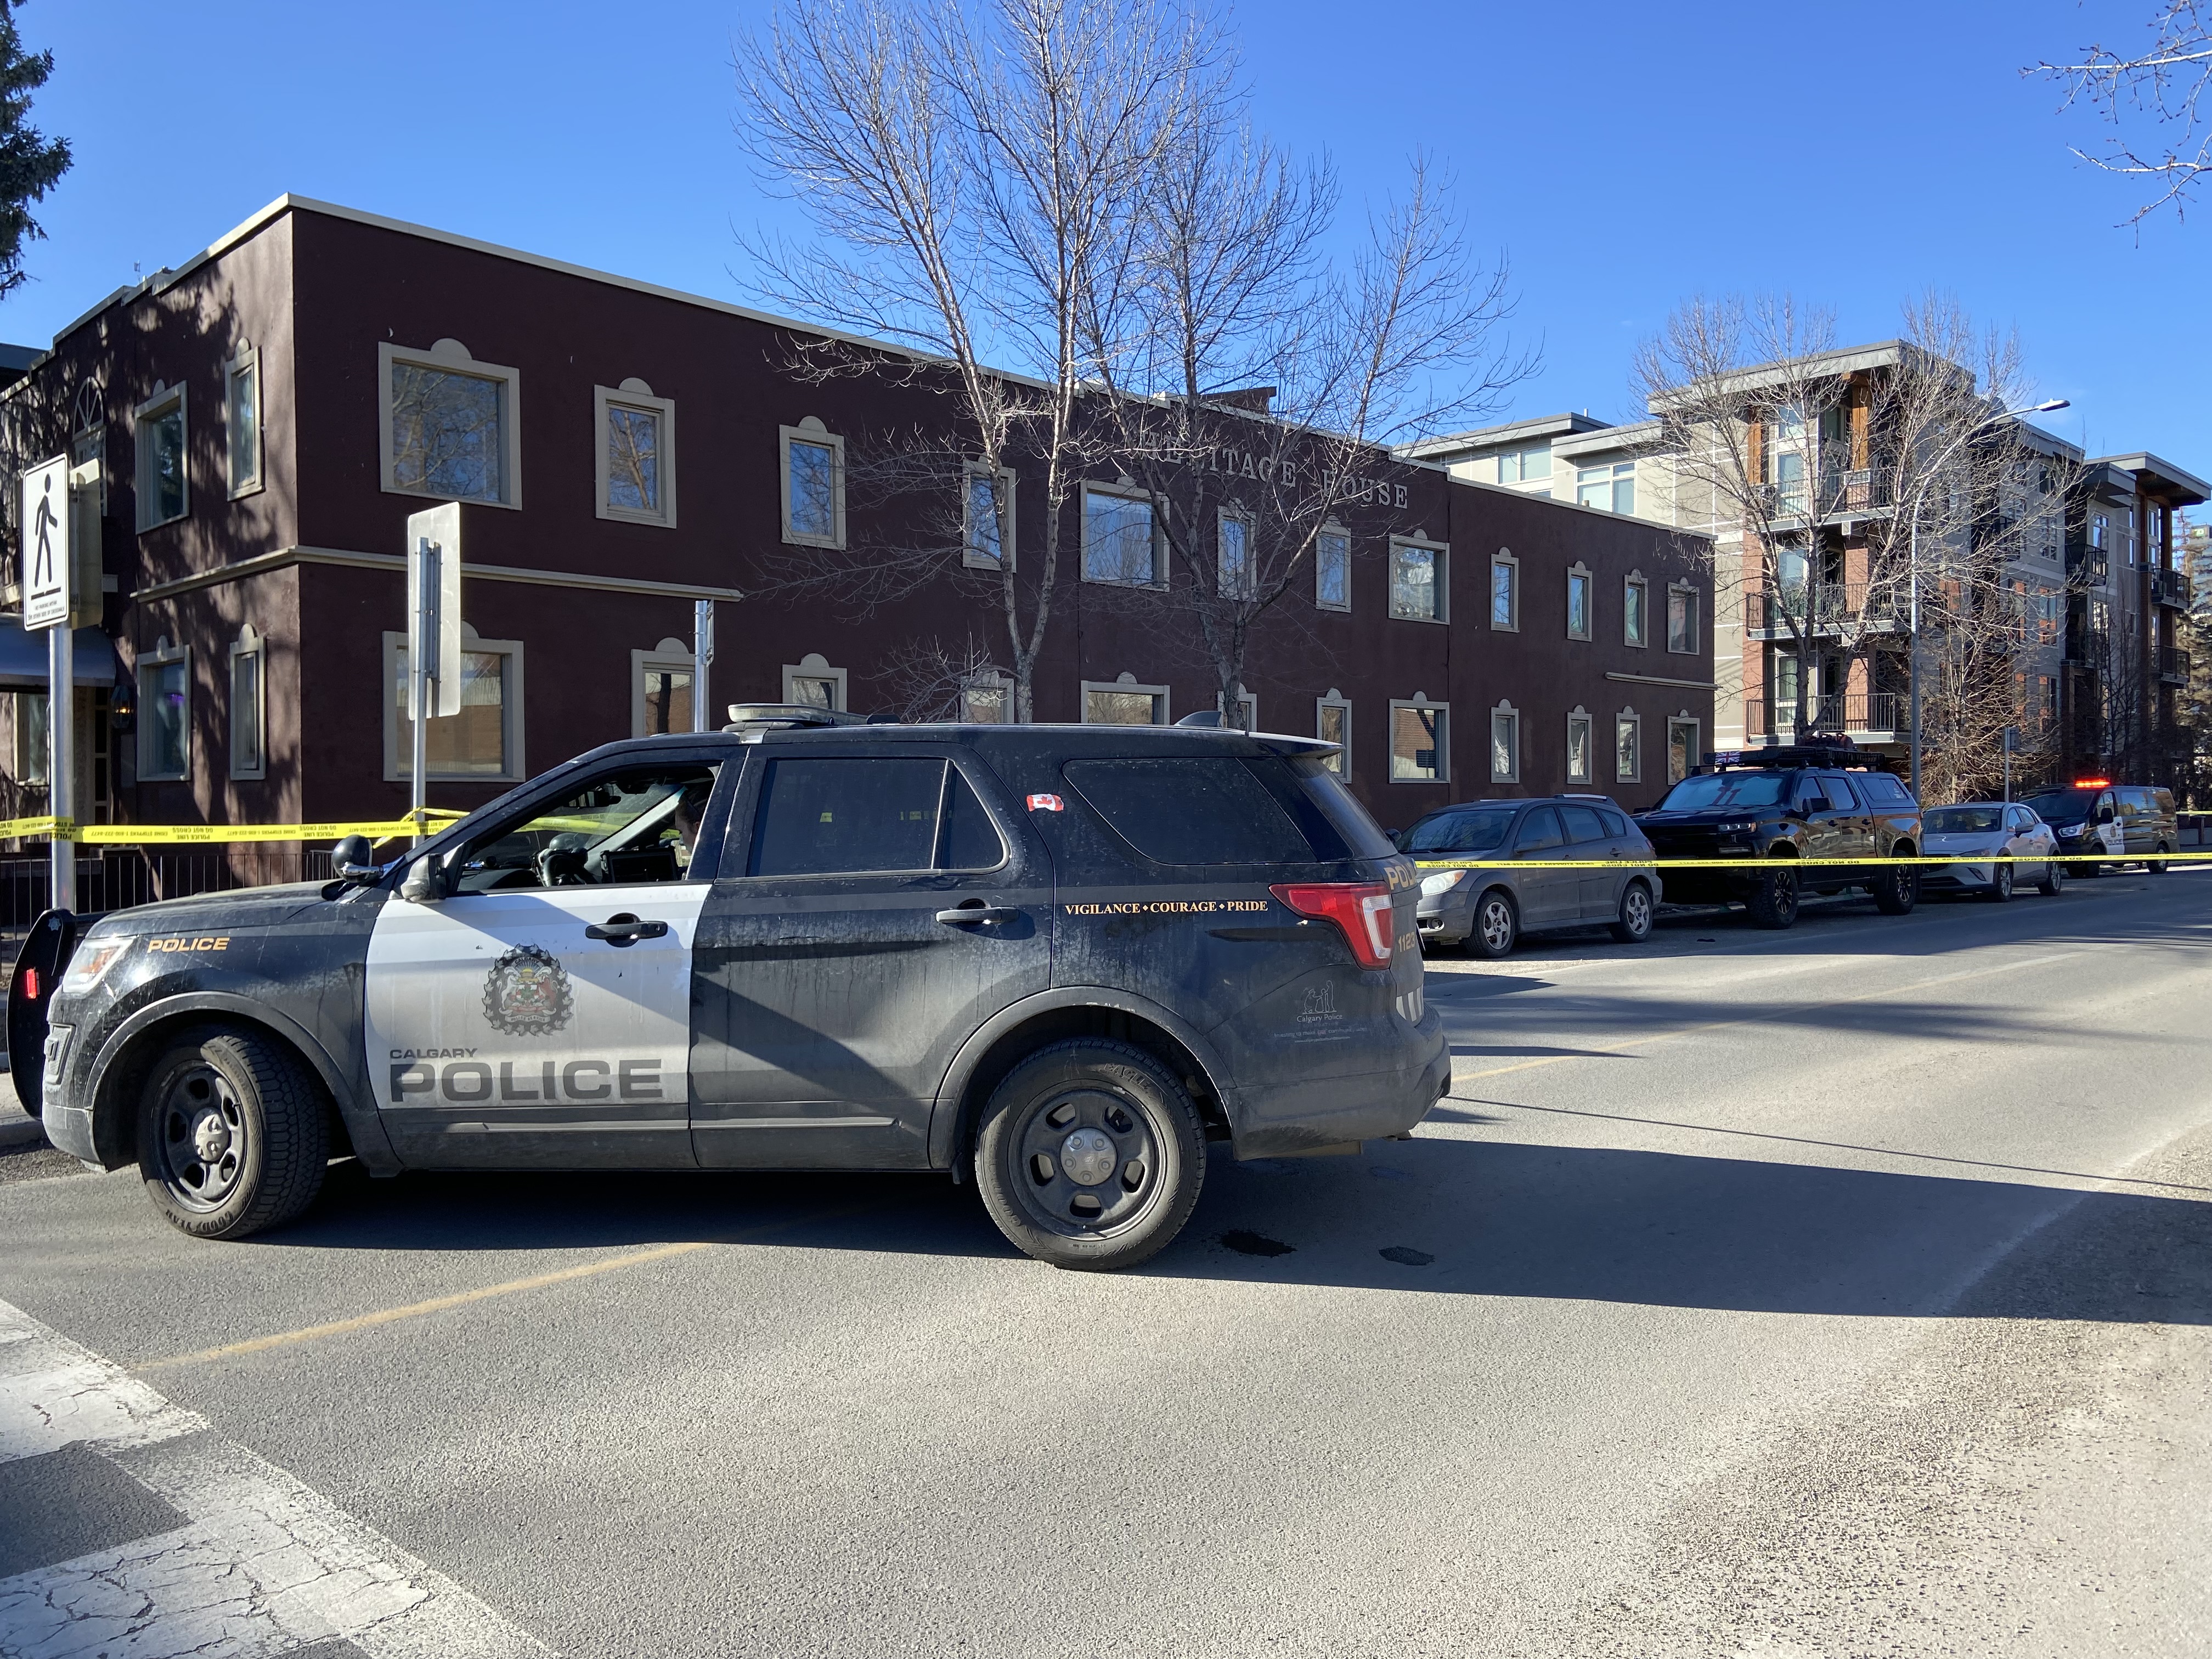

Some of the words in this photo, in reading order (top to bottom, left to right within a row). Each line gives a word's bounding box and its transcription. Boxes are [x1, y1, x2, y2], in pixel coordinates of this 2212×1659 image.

[1142, 431, 1296, 487] HEITAGE
[1384, 862, 1418, 890] POLI
[1065, 904, 1141, 915] VIGILANCE
[1150, 901, 1217, 913] COURAGE
[1227, 900, 1268, 912] PRIDE
[148, 936, 230, 953] POLICE
[1296, 1015, 1322, 1024] Calgary
[390, 1048, 478, 1059] CALGARY
[390, 1059, 663, 1103] POLICE
